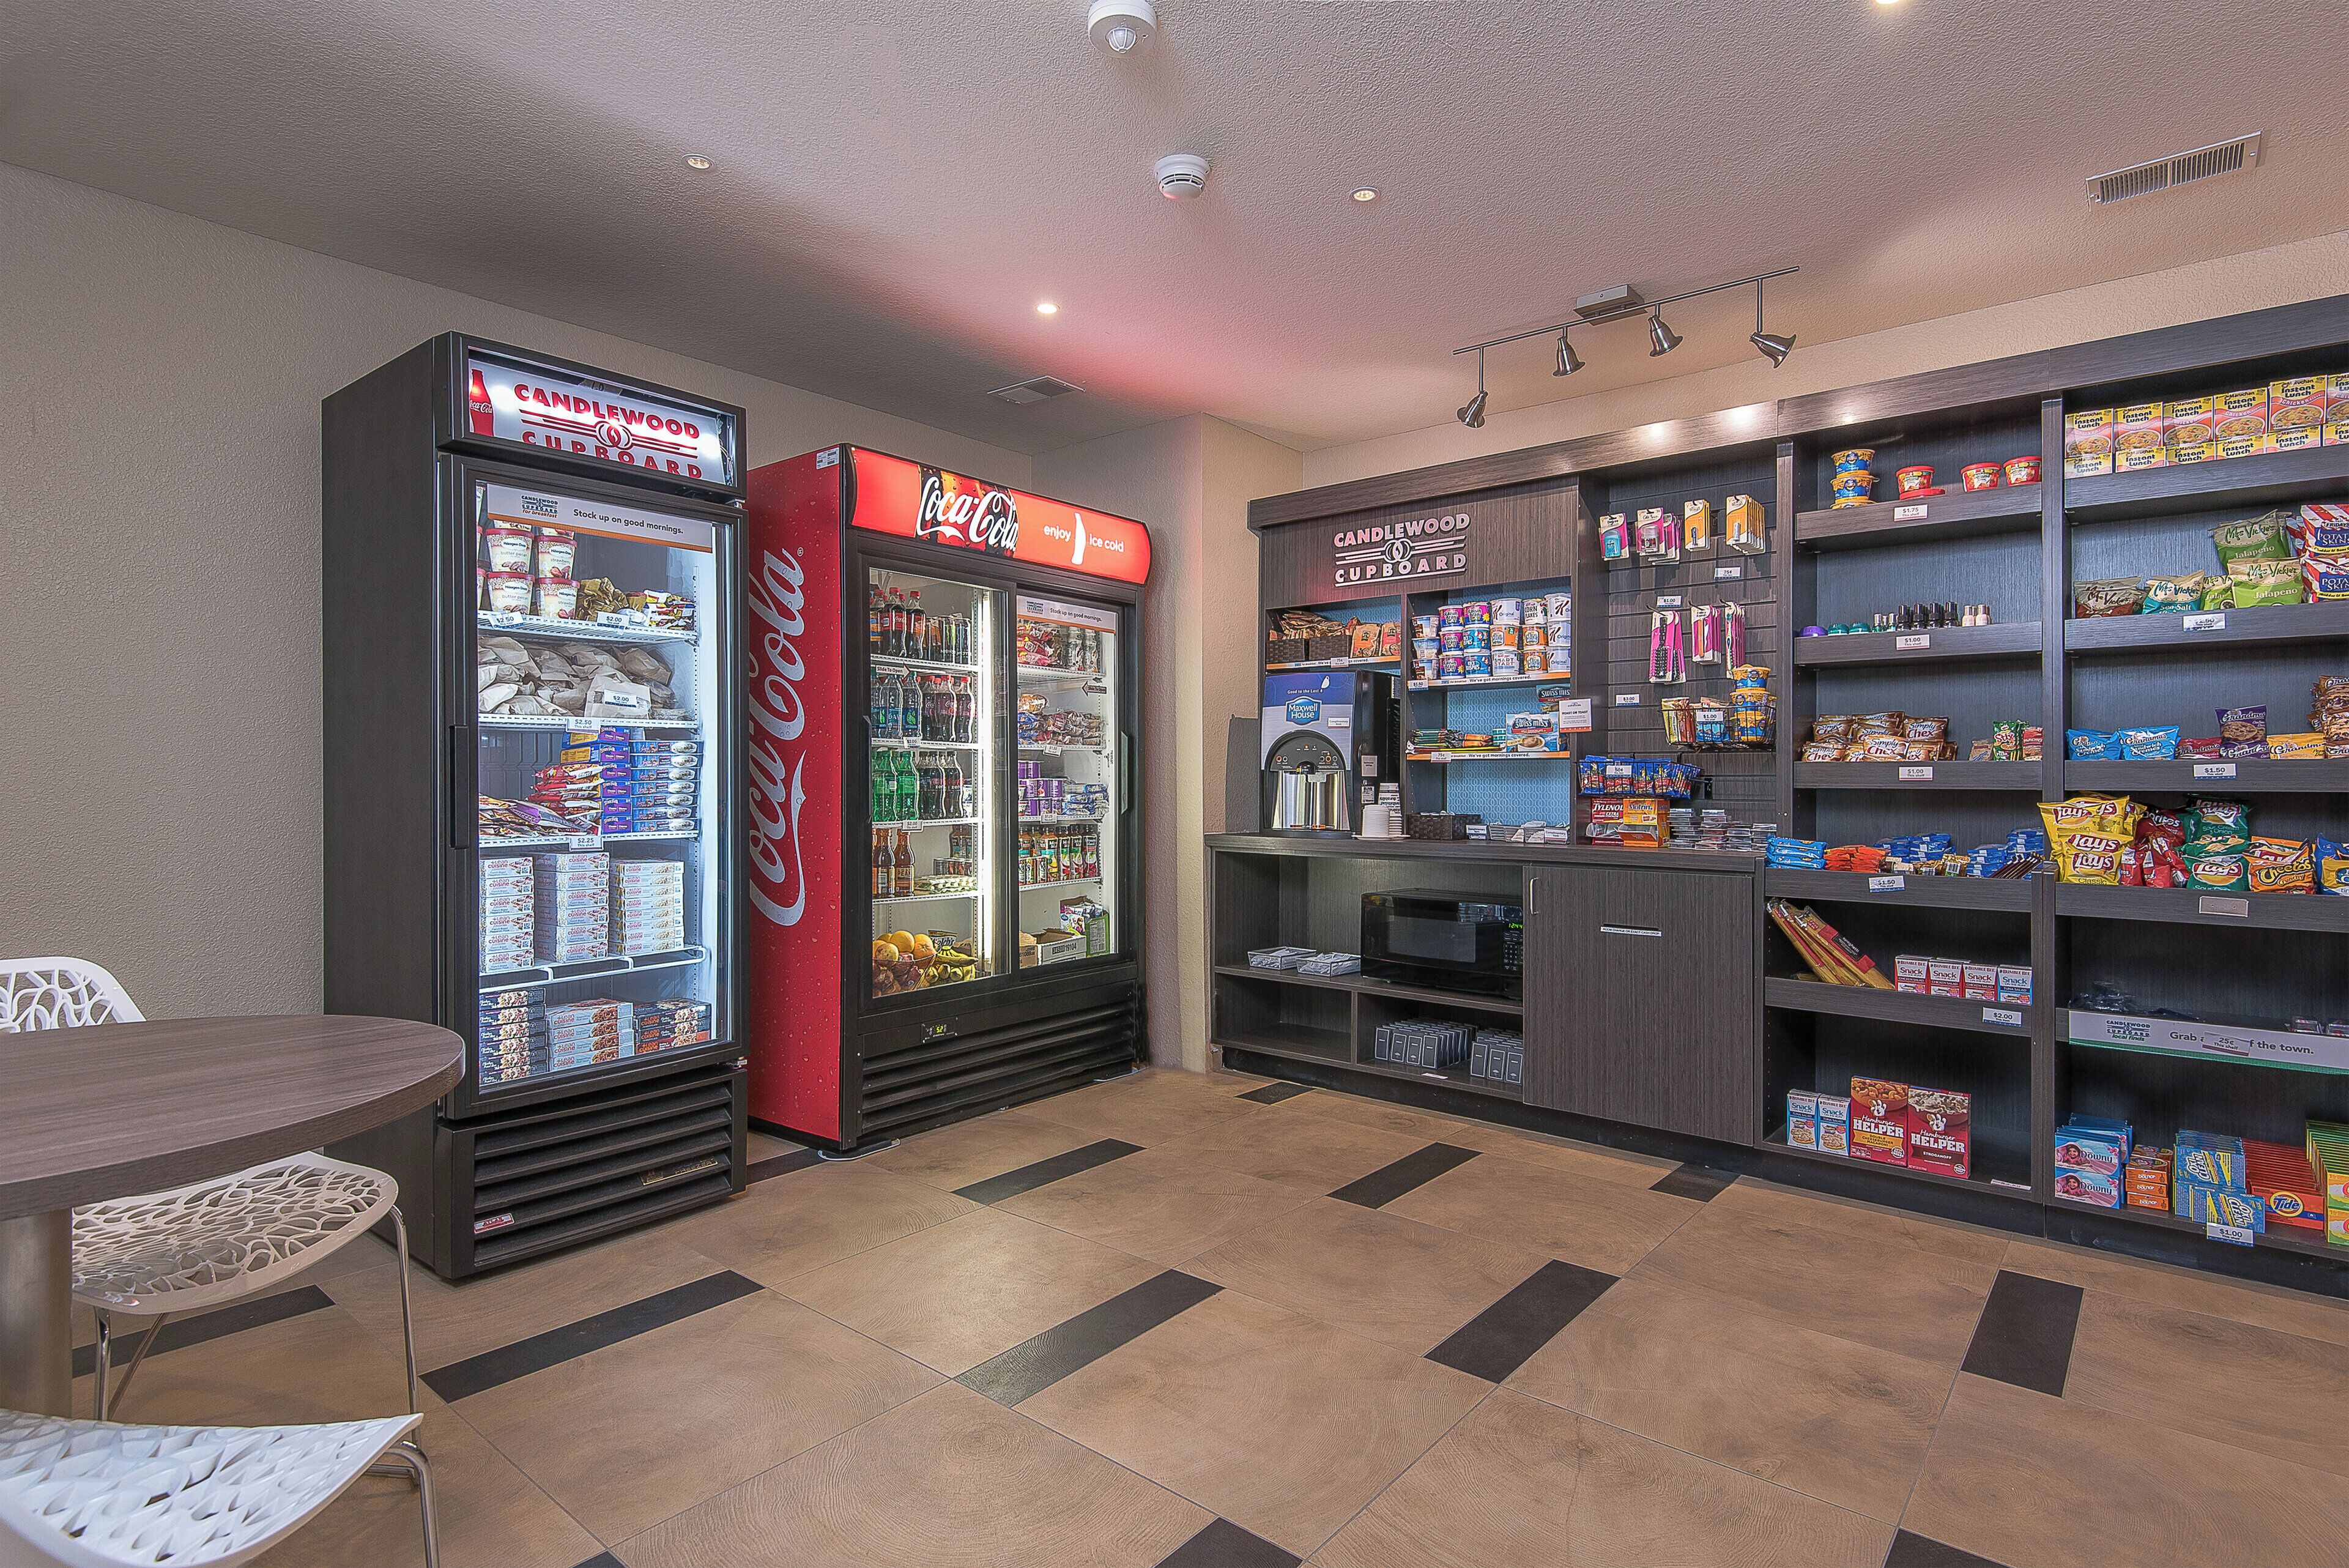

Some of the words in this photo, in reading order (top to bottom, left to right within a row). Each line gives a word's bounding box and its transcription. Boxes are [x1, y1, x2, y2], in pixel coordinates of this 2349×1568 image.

[2282, 385, 2315, 393] Instant
[2224, 396, 2256, 406] Instant
[514, 384, 700, 439] CANDLEWOOD
[2123, 411, 2152, 419] Instant
[522, 431, 702, 479] CUPBOARD
[521, 496, 558, 505] CANDLEWOOD
[917, 476, 1019, 551] Coca-Cola
[573, 509, 596, 519] Stock
[599, 514, 609, 522] up
[647, 524, 683, 534] mornings.
[1334, 513, 1470, 548] CANDLEWOOD
[1044, 525, 1071, 542] enjoy
[1089, 533, 1102, 547] ice
[1105, 538, 1124, 552] cold
[2235, 546, 2275, 559] Jalapeño
[1335, 554, 1467, 582] CUPBOARD
[2254, 589, 2298, 599] Jalapeño
[1907, 729, 1934, 738] Chex
[1871, 738, 1898, 748] Simply
[1867, 746, 1896, 755] Chex
[2259, 859, 2311, 883] Cheetos
[2278, 875, 2304, 886] Crunchy
[2170, 1031, 2195, 1041] Grab
[2257, 1041, 2276, 1050] the
[2279, 1044, 2314, 1054] town.
[1862, 1115, 1895, 1126] Hamburger
[1854, 1120, 1904, 1137] HELPER
[1920, 1129, 1955, 1140] Hamburger
[1911, 1134, 1966, 1153] HELPER
[2081, 1151, 2112, 1163] Downy
[2196, 1153, 2210, 1180] CLEAN
[2080, 1182, 2112, 1195] Downy
[2274, 1197, 2300, 1210] Tide
[2228, 1197, 2245, 1226] CLEAN
[2219, 1228, 2243, 1238] $1.00
